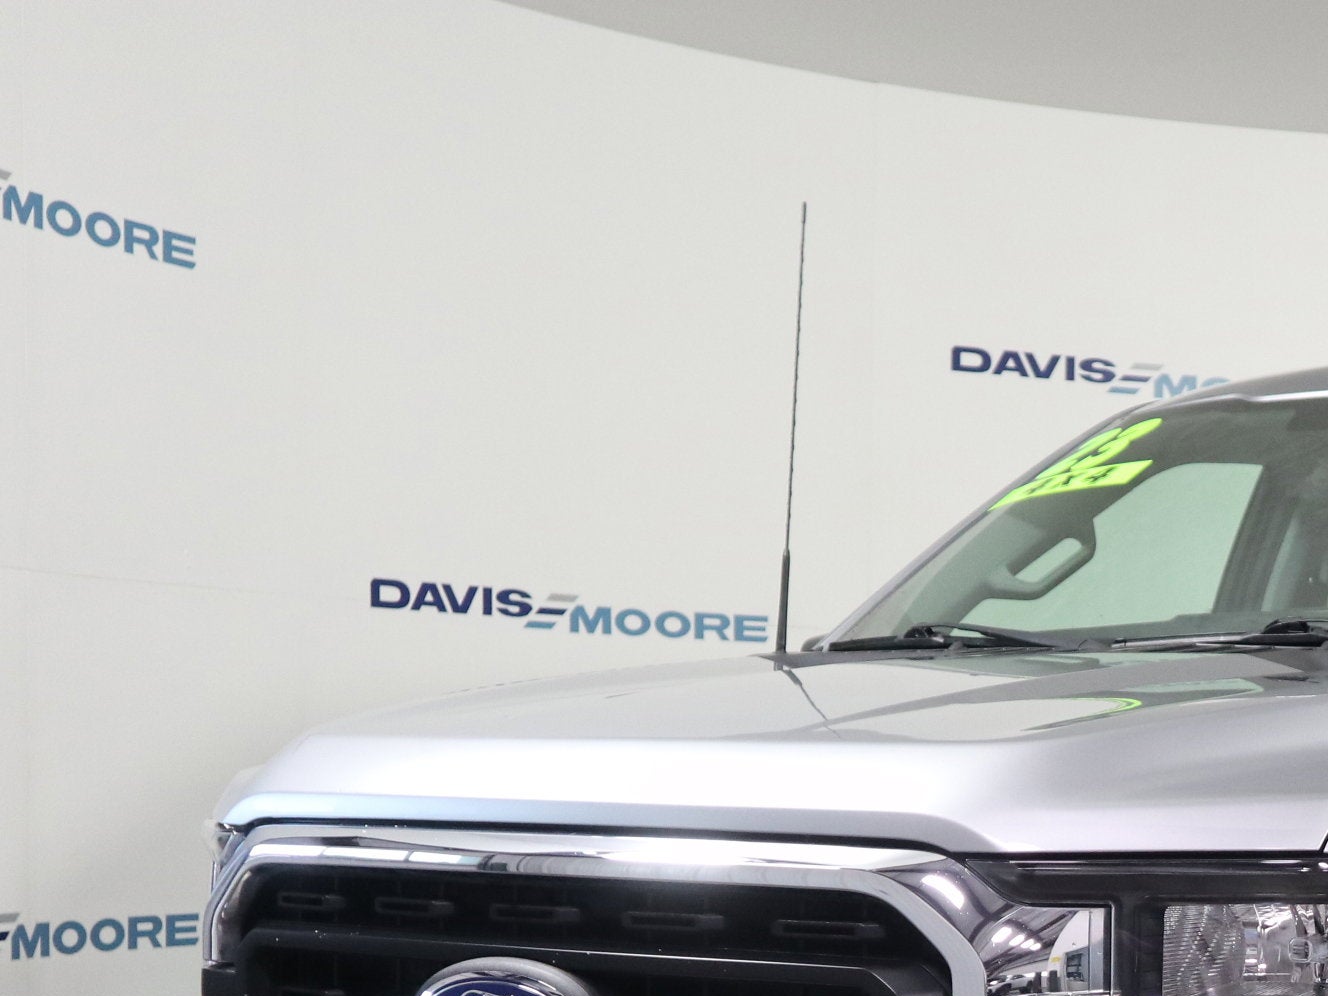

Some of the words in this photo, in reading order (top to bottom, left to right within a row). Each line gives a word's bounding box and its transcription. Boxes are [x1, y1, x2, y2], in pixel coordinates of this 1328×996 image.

[2, 184, 197, 270] MOORE
[951, 345, 1117, 383] DAVIS
[370, 578, 533, 617] DAVIS
[569, 605, 769, 643] MOORE
[11, 913, 199, 961] MOORE
